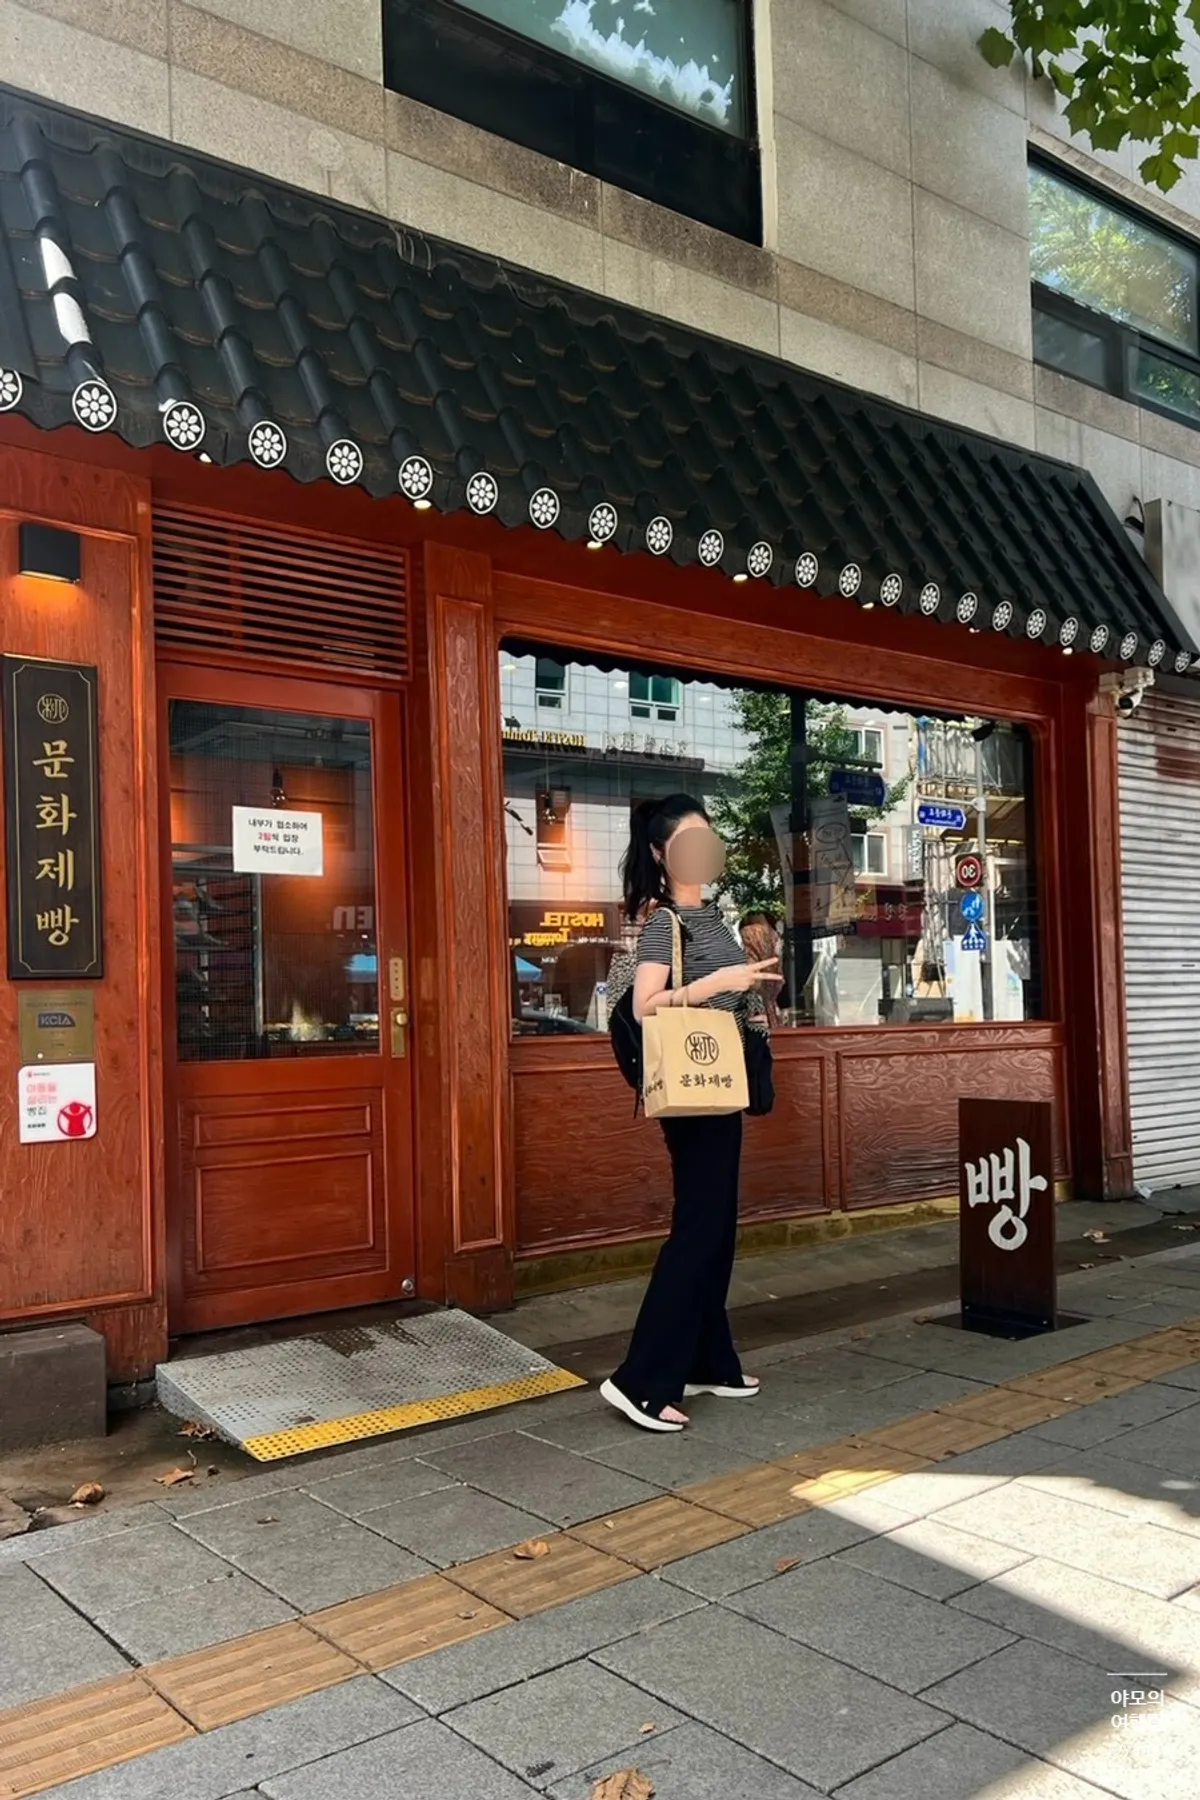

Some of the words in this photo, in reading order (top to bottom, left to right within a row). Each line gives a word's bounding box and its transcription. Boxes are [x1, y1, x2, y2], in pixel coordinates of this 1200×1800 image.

[248, 818, 272, 829] 내부가
[32, 739, 80, 946] 문화제빵
[283, 833, 299, 843] 입장
[679, 1073, 733, 1089] 문화제빵
[964, 1137, 1048, 1251] 빵
